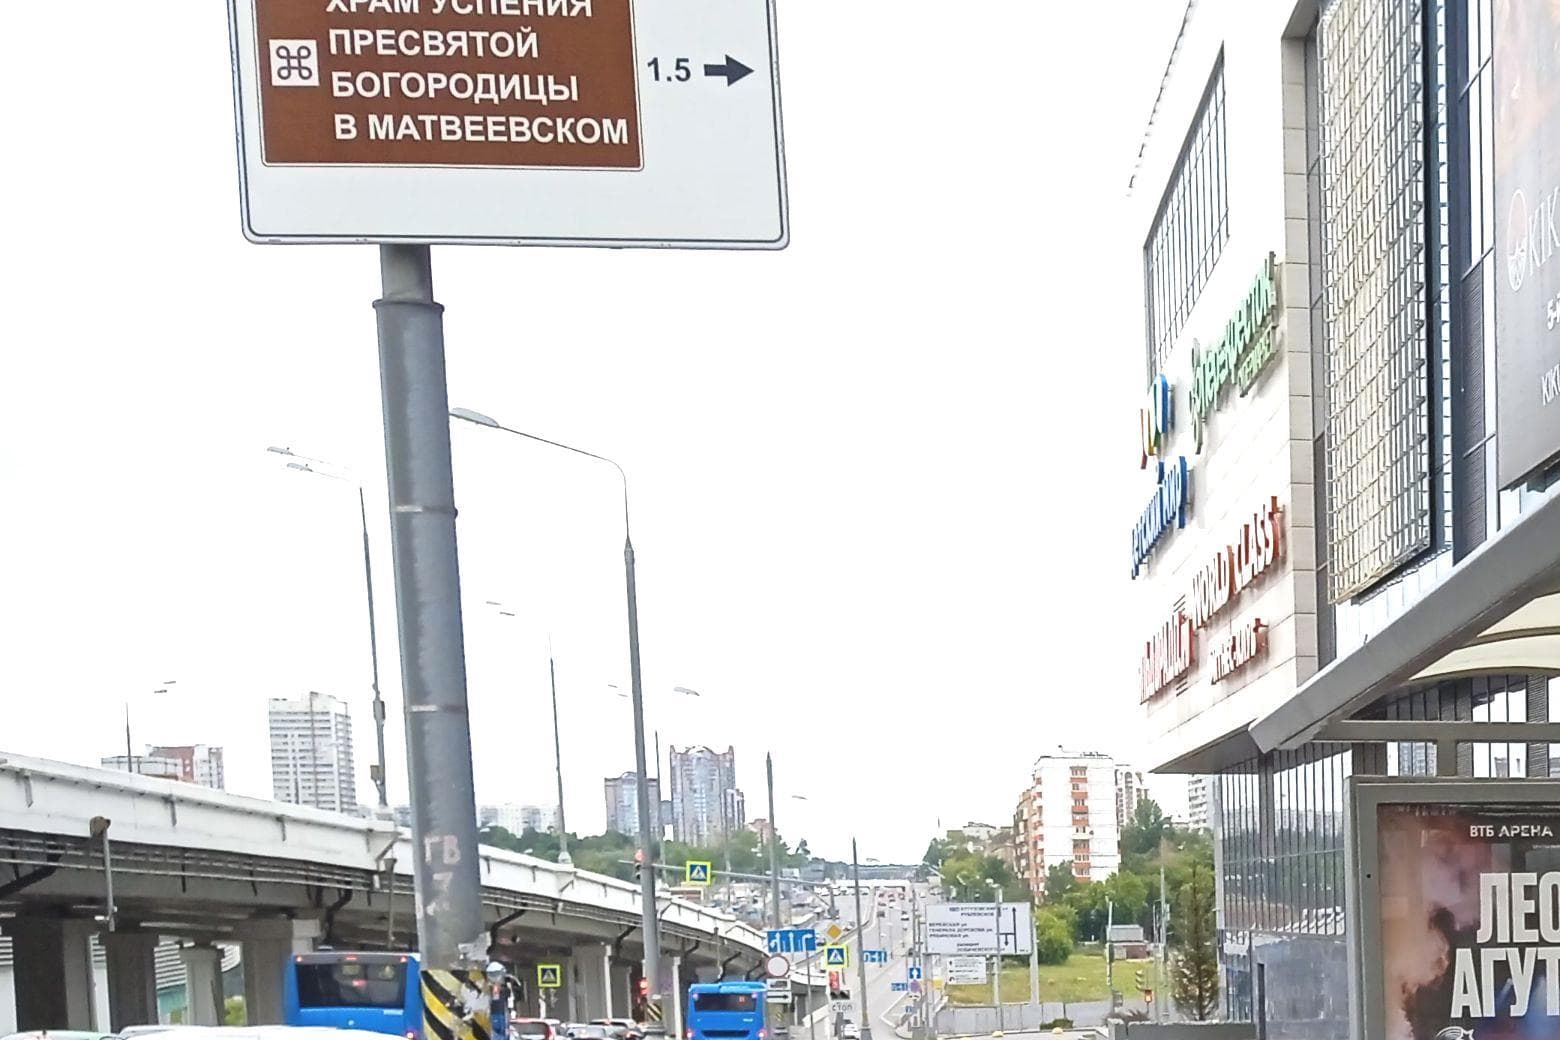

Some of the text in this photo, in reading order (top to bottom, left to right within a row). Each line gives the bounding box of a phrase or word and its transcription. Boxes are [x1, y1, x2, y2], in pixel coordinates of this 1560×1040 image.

[329, 26, 539, 58] ПРЕСВЯТОЙ
[647, 57, 692, 83] 1.5
[331, 72, 579, 103] БОГОРОДИЦЫ
[335, 115, 629, 145] В МАТВЕЕВСКОМ
[1233, 496, 1280, 594] CLASS
[1469, 825, 1553, 838] ВТБ АРЕНА
